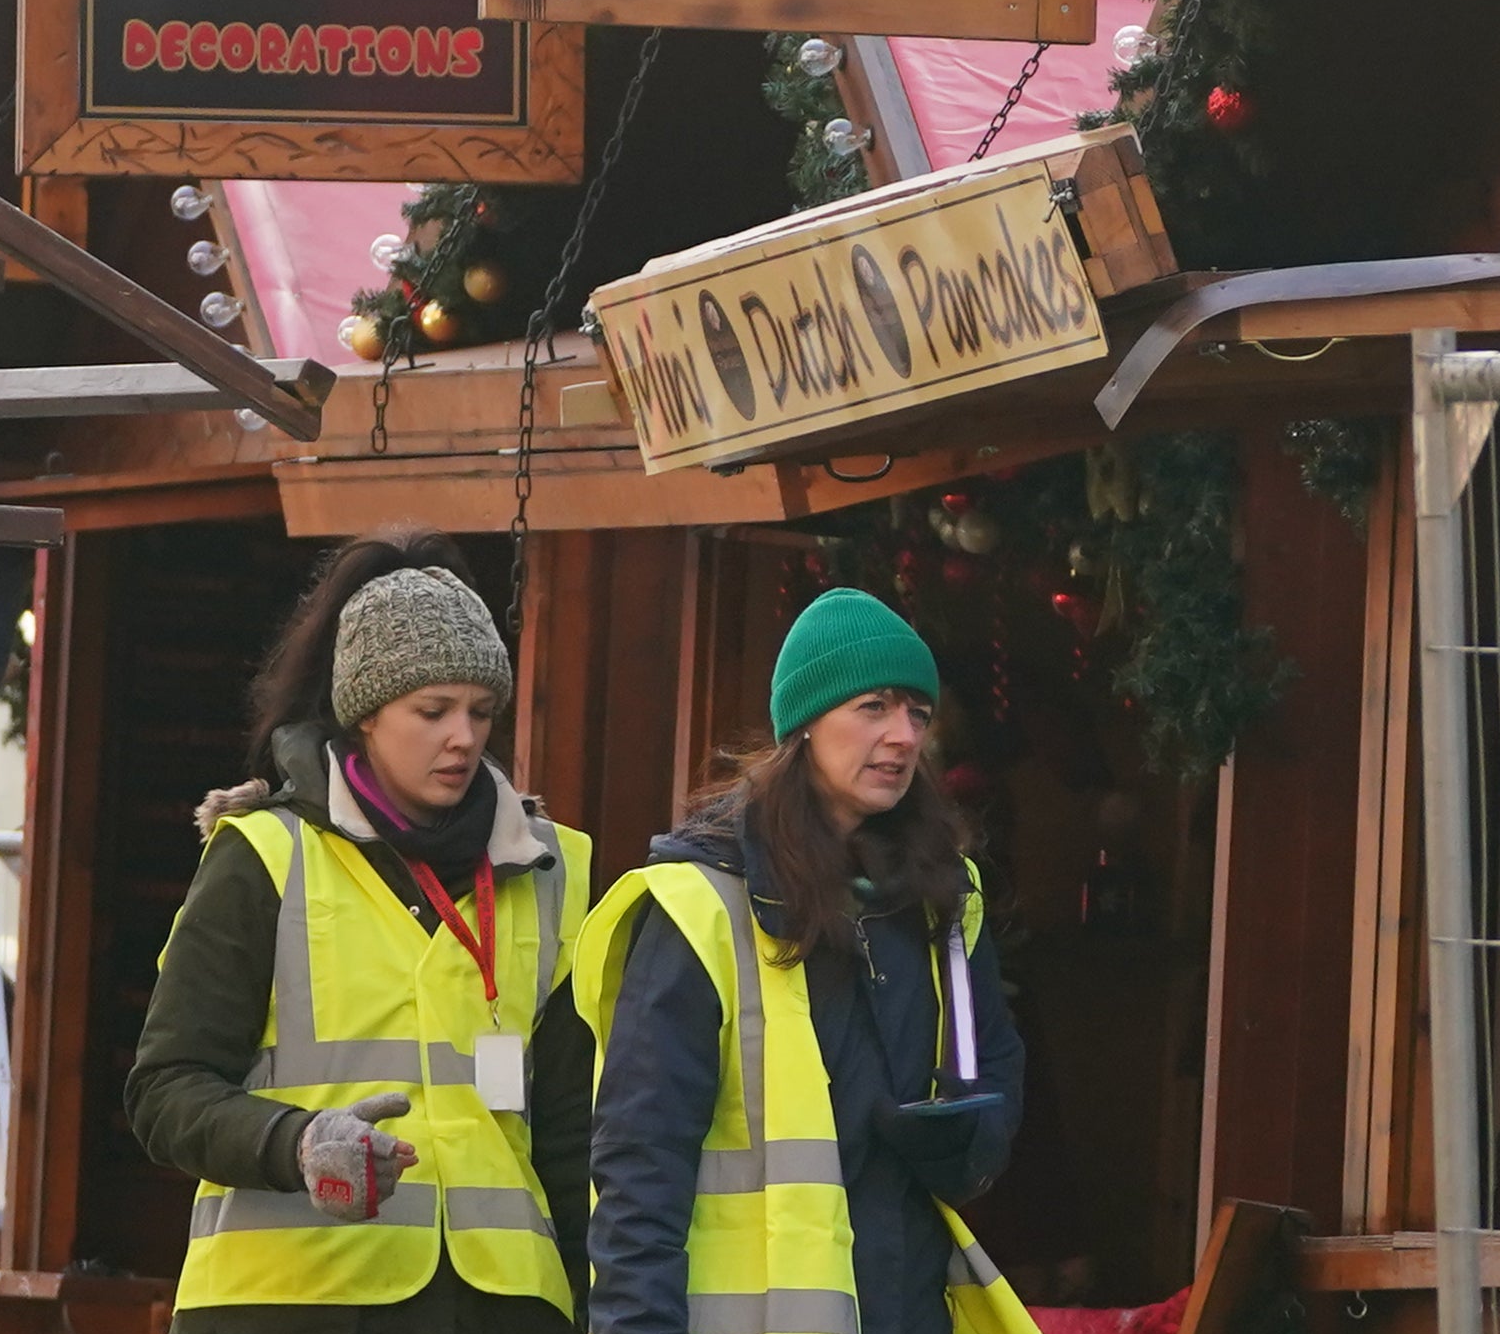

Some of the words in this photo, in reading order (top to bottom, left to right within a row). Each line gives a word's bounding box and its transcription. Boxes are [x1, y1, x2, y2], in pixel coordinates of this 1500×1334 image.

[123, 18, 484, 79] DECORATIONS
[617, 296, 714, 448] Mini
[739, 257, 875, 413] Dutch
[896, 202, 1089, 368] Pancakes
